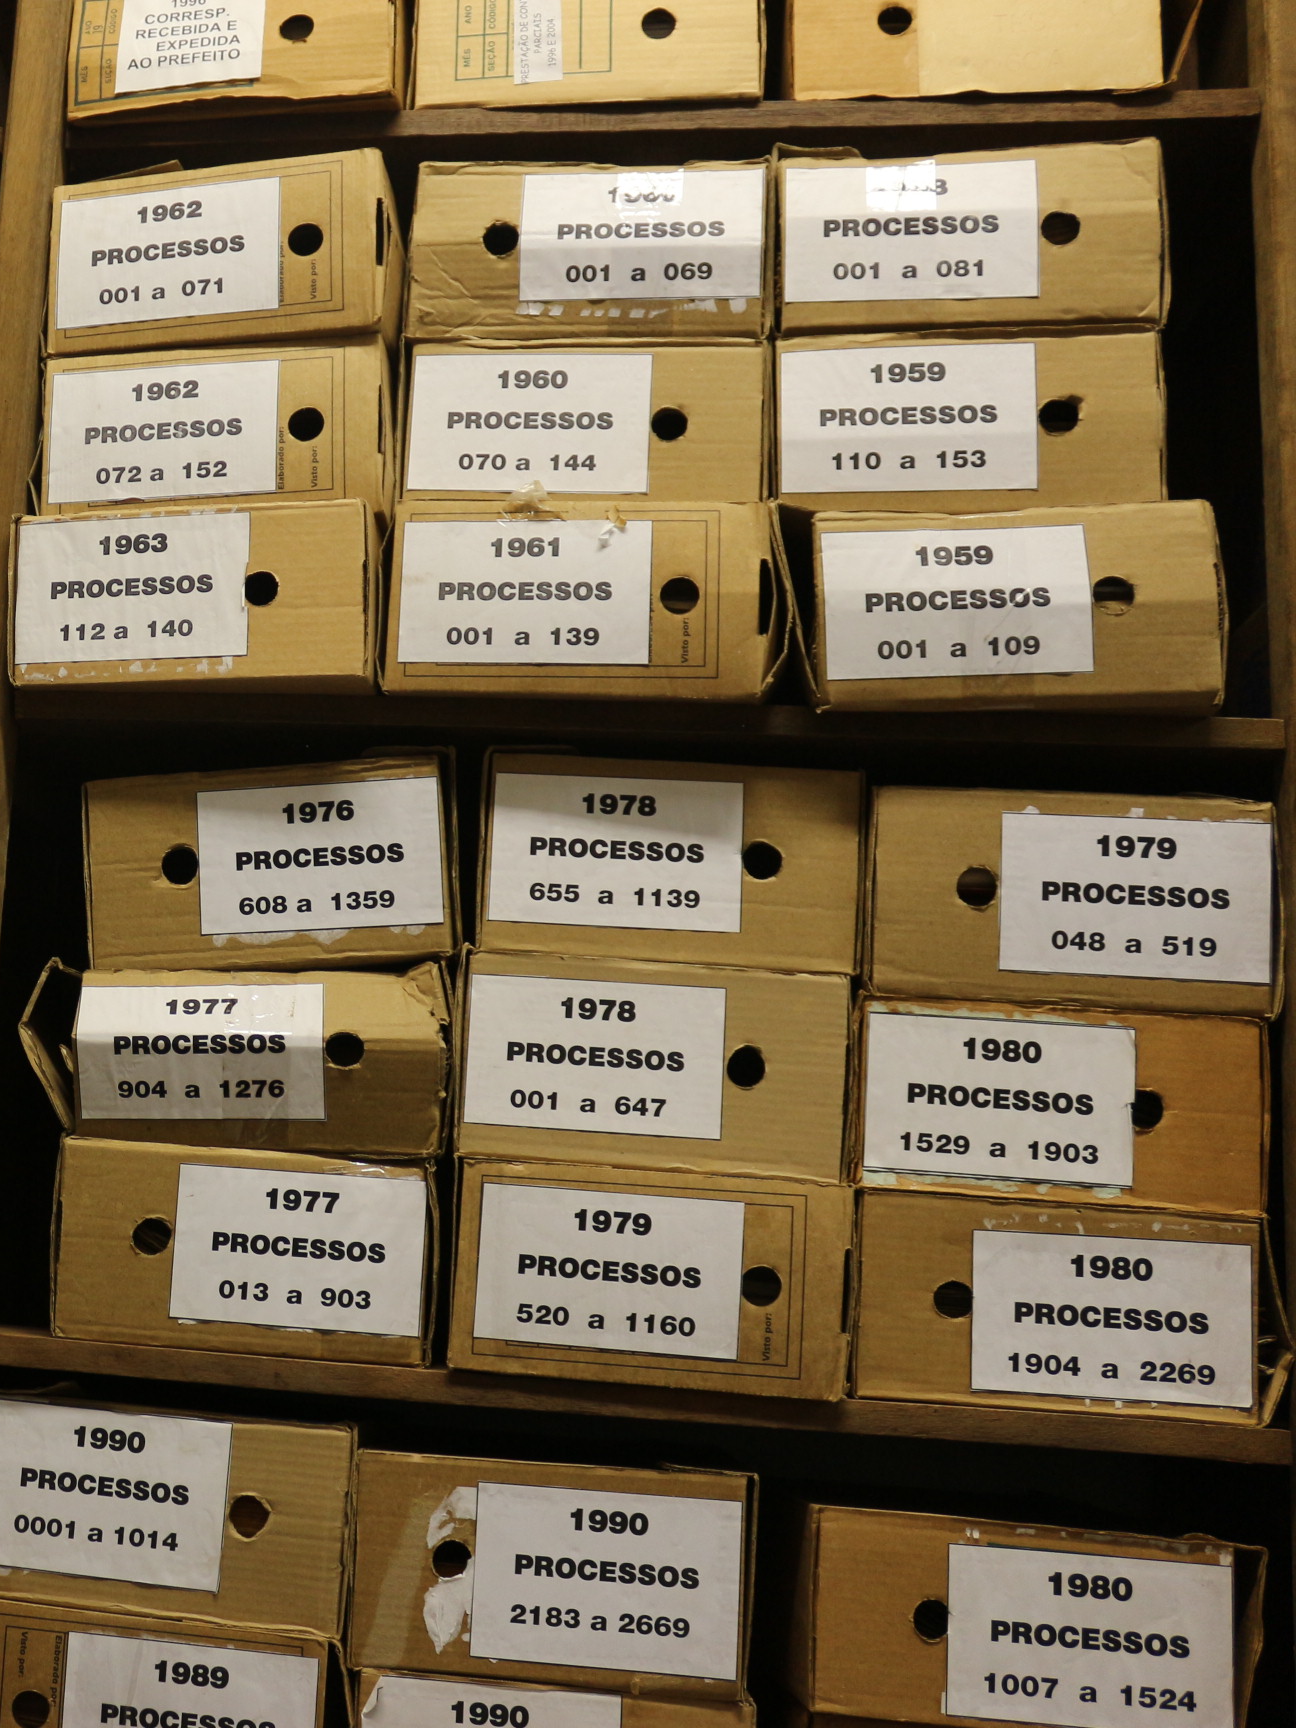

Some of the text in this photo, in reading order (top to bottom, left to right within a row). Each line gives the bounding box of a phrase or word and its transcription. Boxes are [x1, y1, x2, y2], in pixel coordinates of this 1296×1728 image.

[135, 20, 238, 40] RECEBIDA E
[144, 7, 230, 25] CORRESP.
[547, 18, 556, 38] 2004
[156, 34, 241, 52] EXPEDIDA
[533, 12, 542, 54] PARCIAIS
[127, 48, 241, 70] AO PREFEITO
[488, 41, 496, 71] SEÇÃO
[518, 21, 529, 83] PRESTAÇÃO DE
[137, 200, 203, 224] 1962
[91, 234, 245, 267] PROCESSOS
[99, 277, 223, 305] 001 a 071
[497, 369, 569, 390] 1960
[870, 361, 946, 384] 1959
[447, 411, 614, 430] PROCESSOS
[819, 404, 998, 427] PROCESSOS
[458, 453, 597, 472] 070 a 144
[831, 449, 987, 471] 110 a 153
[281, 799, 355, 825] 1976
[235, 842, 405, 872] PROCESSOS
[238, 889, 396, 916] 608 a 1359
[1070, 1254, 1154, 1282] 1980
[1014, 1301, 1210, 1335] PROCESSOS
[1007, 1352, 1216, 1386] 1904 a 2269
[73, 1425, 146, 1454] 1990
[19, 1466, 190, 1506] PROCESSOS
[13, 1514, 179, 1552] 0001 a 1014
[1047, 1571, 1134, 1602] 1980
[990, 1619, 1191, 1659] PROCESSOS
[983, 1672, 1197, 1713] 1007 a 1524
